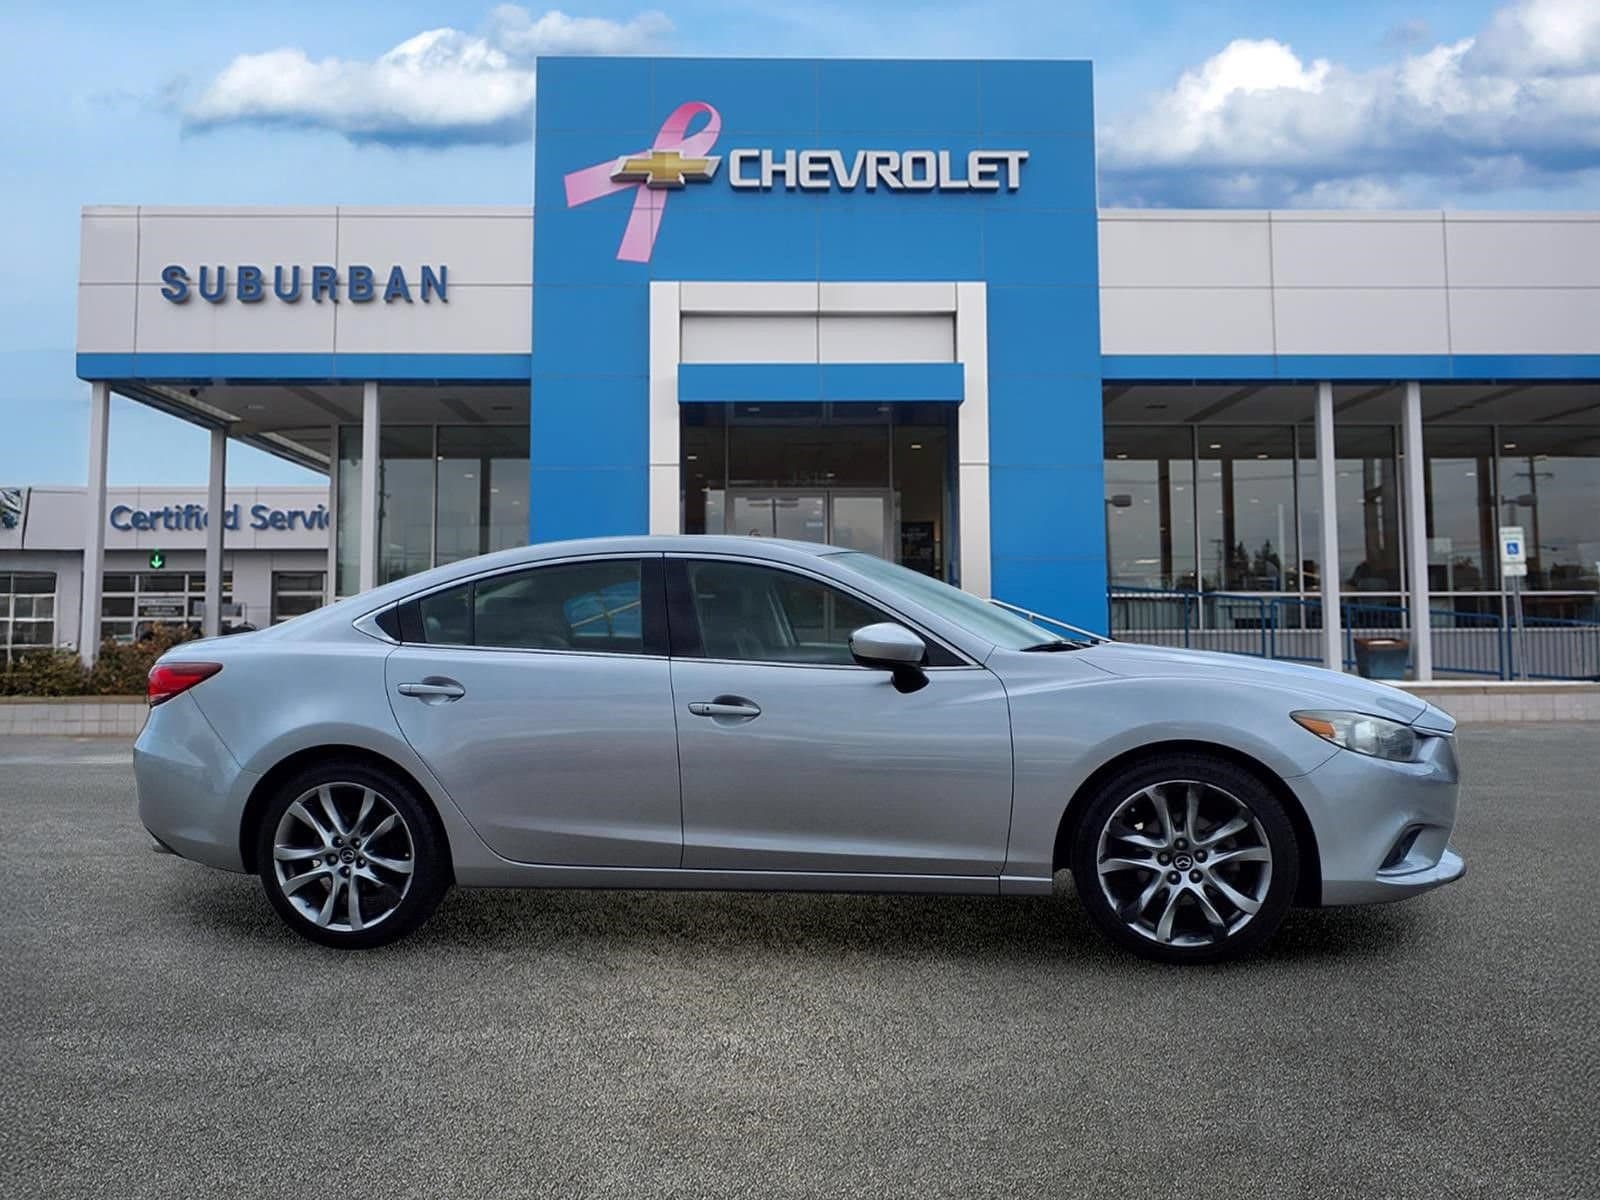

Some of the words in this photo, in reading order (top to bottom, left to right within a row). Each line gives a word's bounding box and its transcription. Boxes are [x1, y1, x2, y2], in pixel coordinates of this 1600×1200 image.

[729, 149, 1030, 190] CHEVROLET
[160, 264, 449, 304] SUBURBAN
[110, 503, 240, 531] Certifid
[249, 503, 330, 530] Servi
